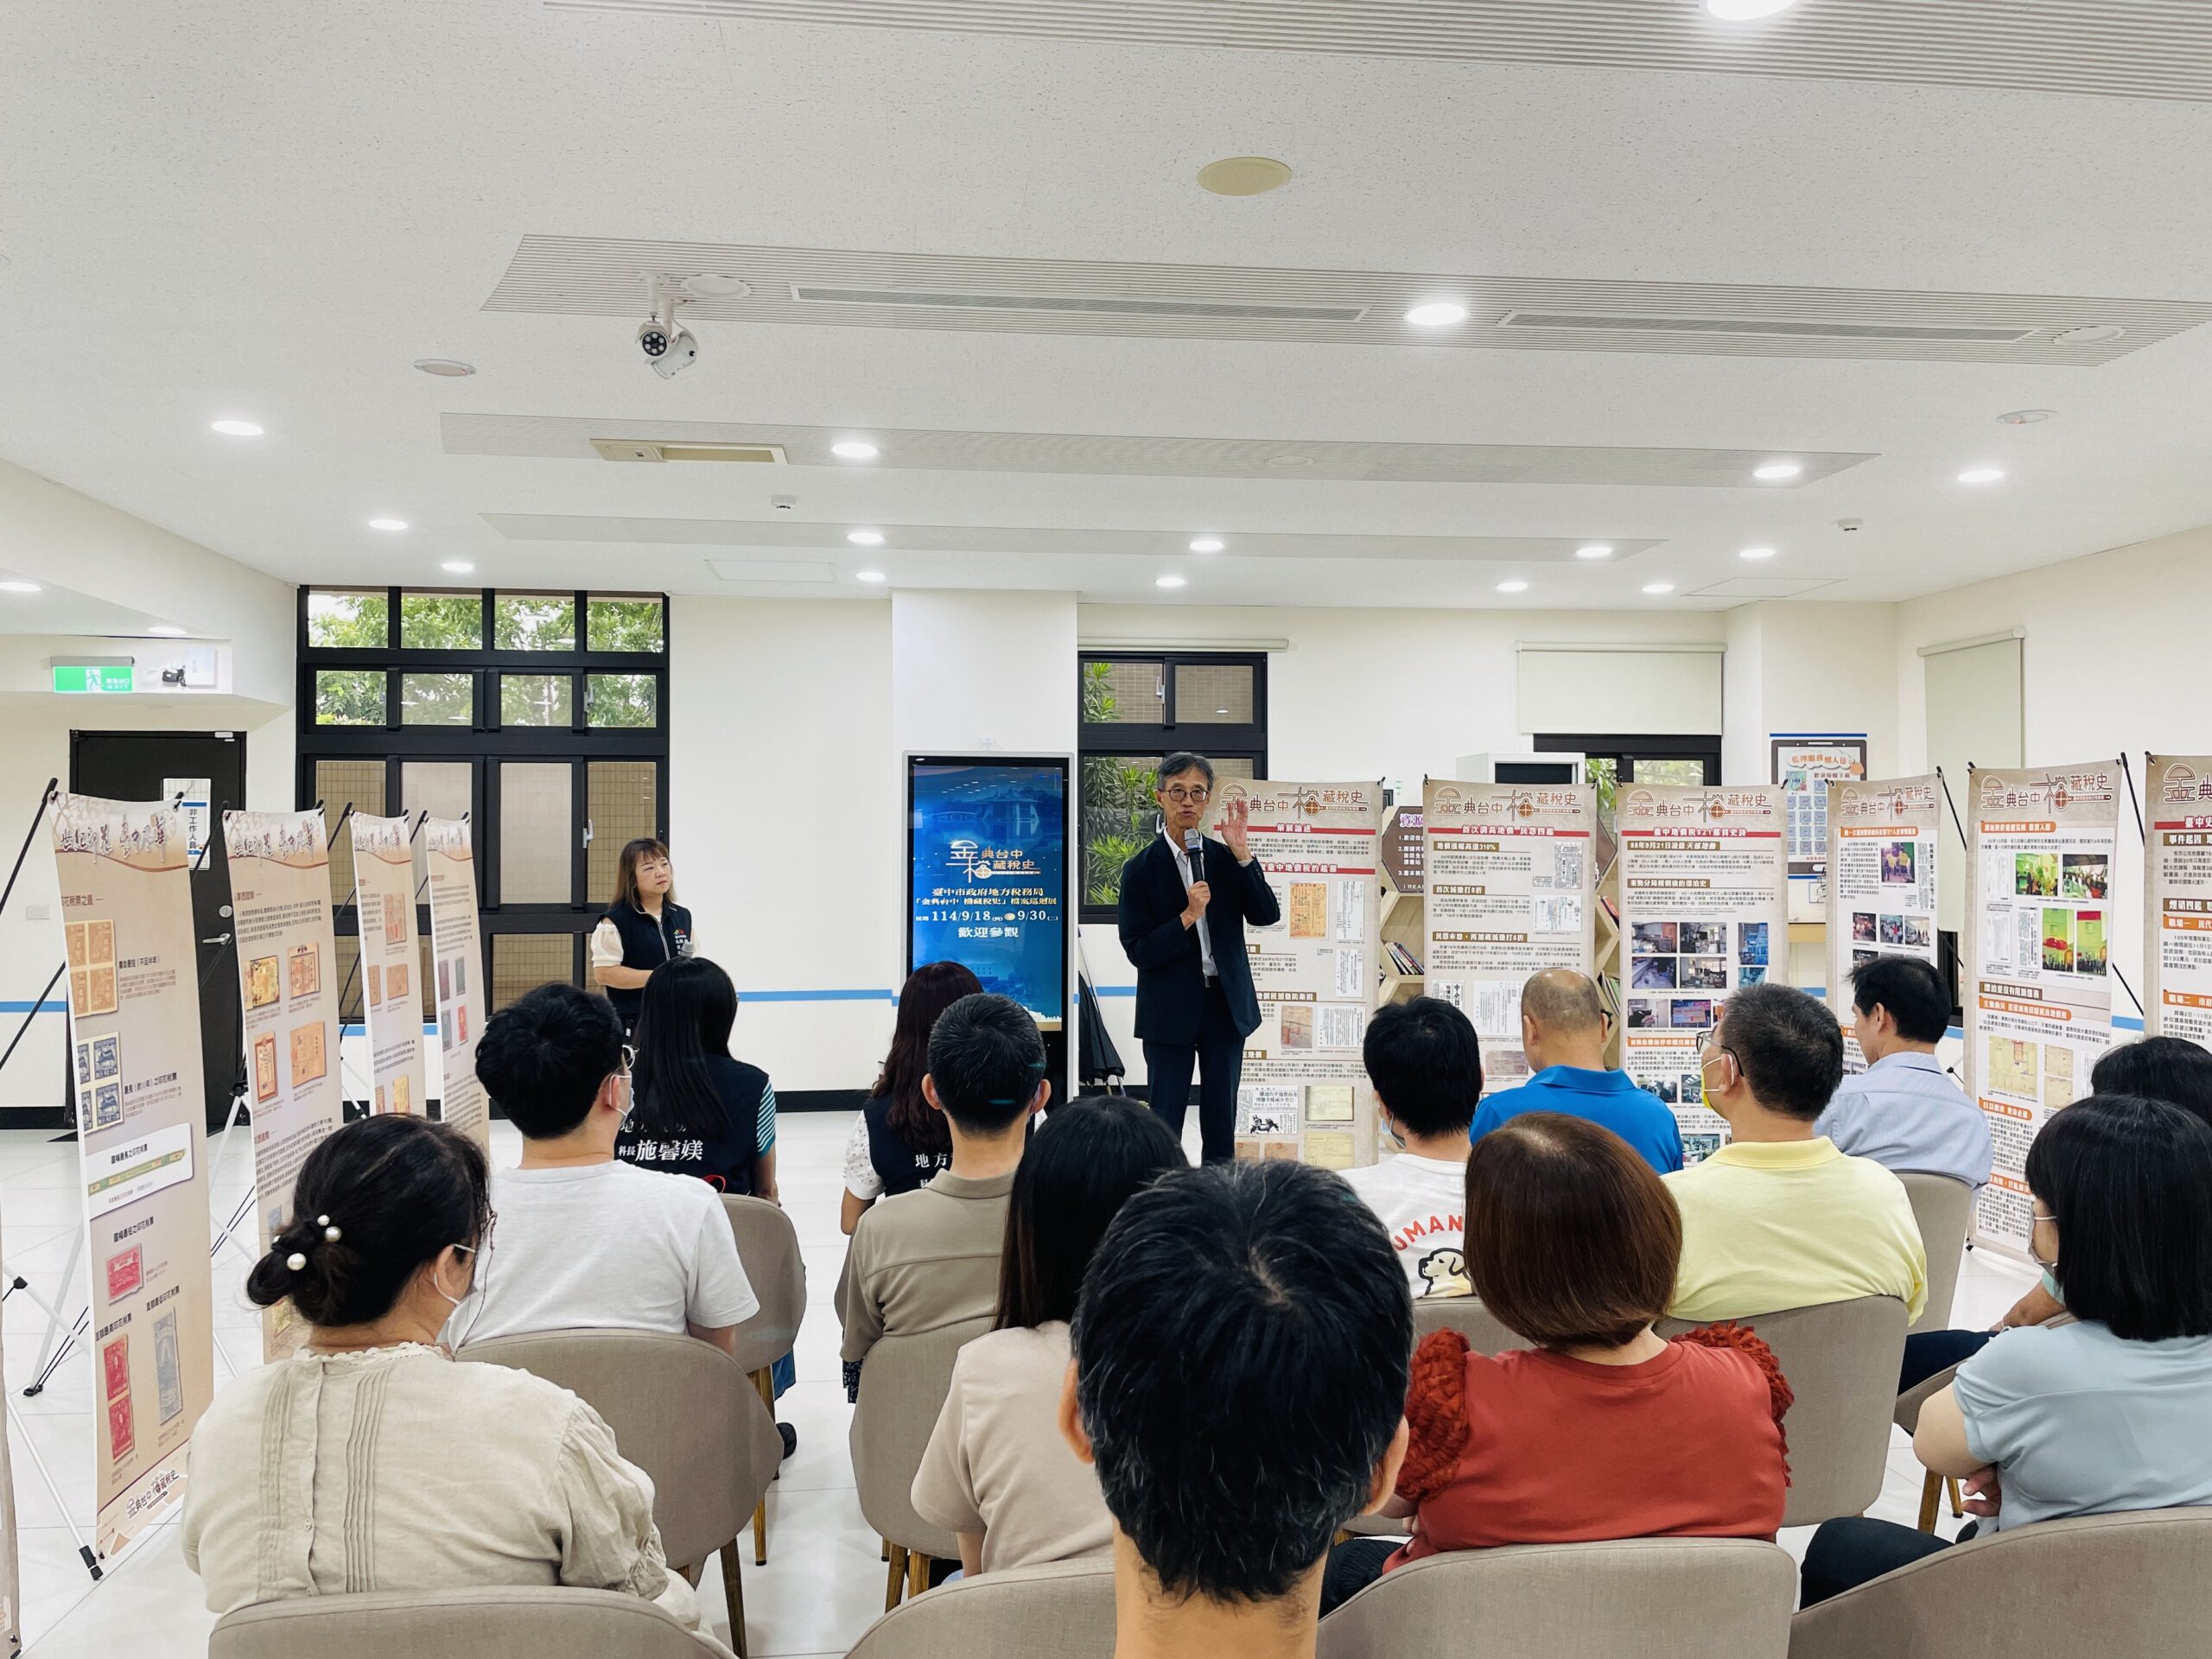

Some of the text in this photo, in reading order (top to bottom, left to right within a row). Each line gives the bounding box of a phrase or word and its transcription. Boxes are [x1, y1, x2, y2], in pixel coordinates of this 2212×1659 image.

[931, 887, 1044, 897] 臺中市政府地方稅務局
[957, 926, 1020, 938] 歡迎參觀
